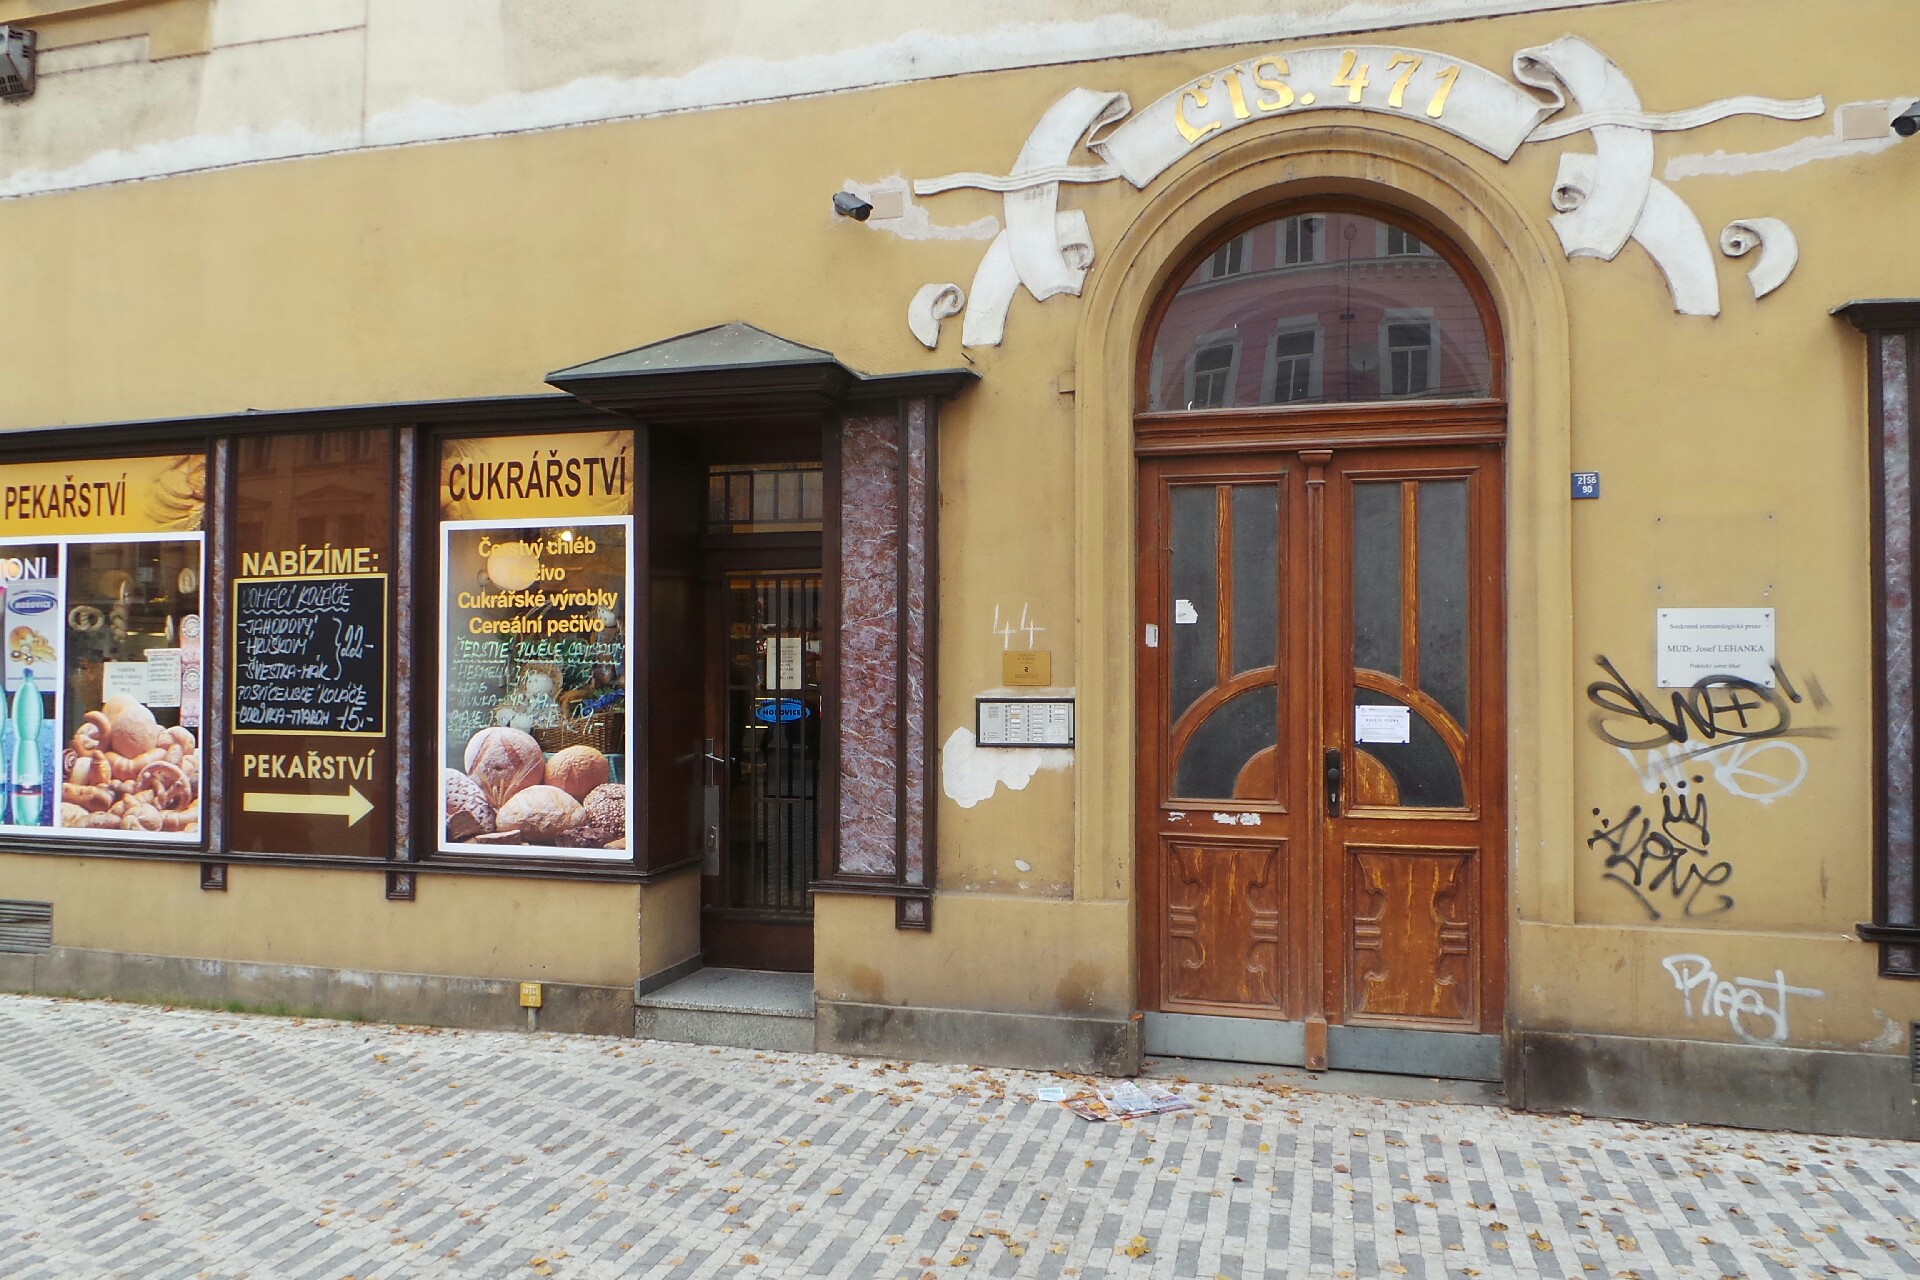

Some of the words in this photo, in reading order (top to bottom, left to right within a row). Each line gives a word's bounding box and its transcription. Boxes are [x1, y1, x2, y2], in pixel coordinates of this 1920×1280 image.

[1331, 49, 1461, 118] 471
[449, 446, 627, 501] CUKRÁŘSTVÍ
[5, 473, 127, 520] PEKAŘSTVÍ
[242, 543, 379, 576] NABÍZÍME:
[548, 536, 596, 555] chléb
[457, 590, 546, 609] Cukrářské
[550, 588, 618, 611] výrobky
[469, 615, 543, 634] Cereální
[547, 615, 606, 637] pečivo
[1667, 645, 1693, 653] MUDr.
[1695, 645, 1717, 653] Josef
[1718, 645, 1765, 653] LEHANKA
[244, 748, 376, 780] PEKAŘSTVÍ
